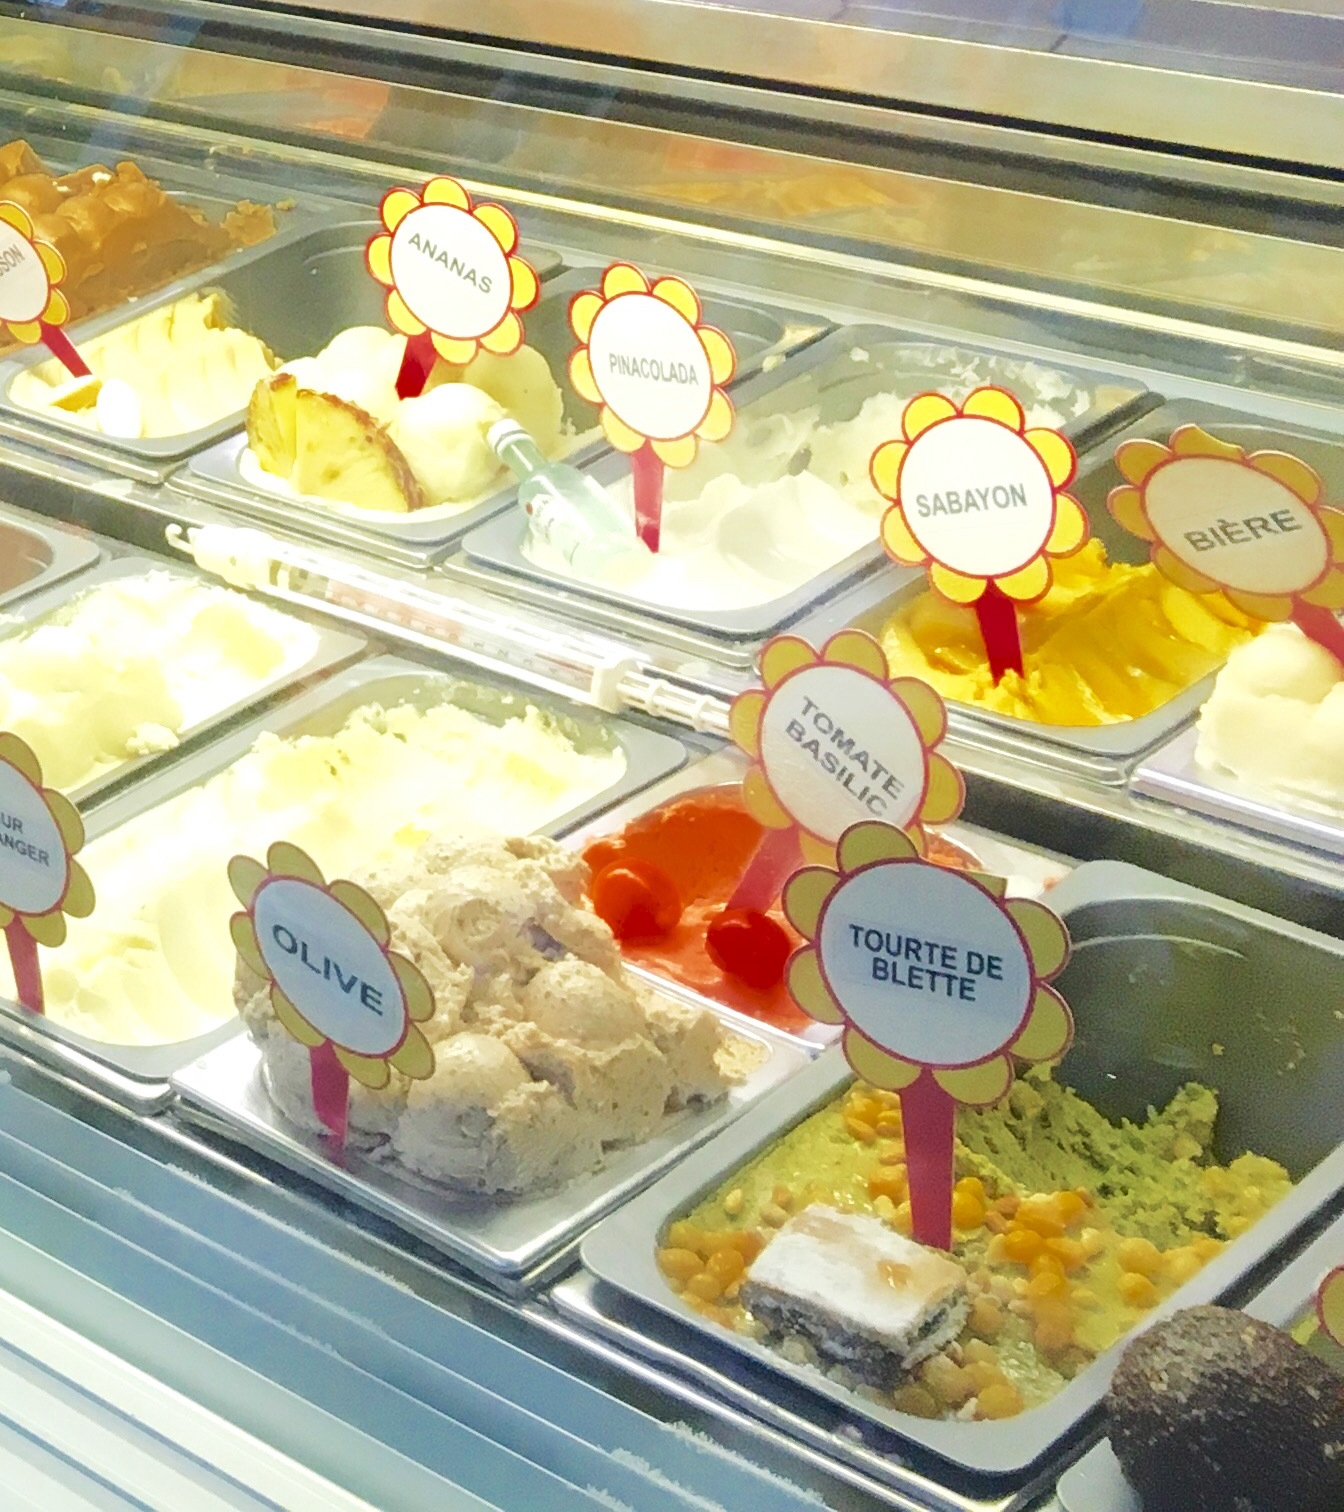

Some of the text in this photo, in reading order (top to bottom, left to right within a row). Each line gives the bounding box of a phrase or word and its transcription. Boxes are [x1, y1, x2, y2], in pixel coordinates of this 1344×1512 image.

[406, 231, 494, 295] ANANAS
[608, 351, 700, 387] PINACOLADA
[914, 482, 1028, 520] SABAYON
[1183, 506, 1304, 554] BIÈRE
[784, 716, 890, 819] BASILIC
[800, 695, 907, 802] TOMATE
[271, 922, 386, 1018] OLIVE
[848, 922, 1005, 982] TOURTE DE
[870, 955, 978, 1002] BLETTE
